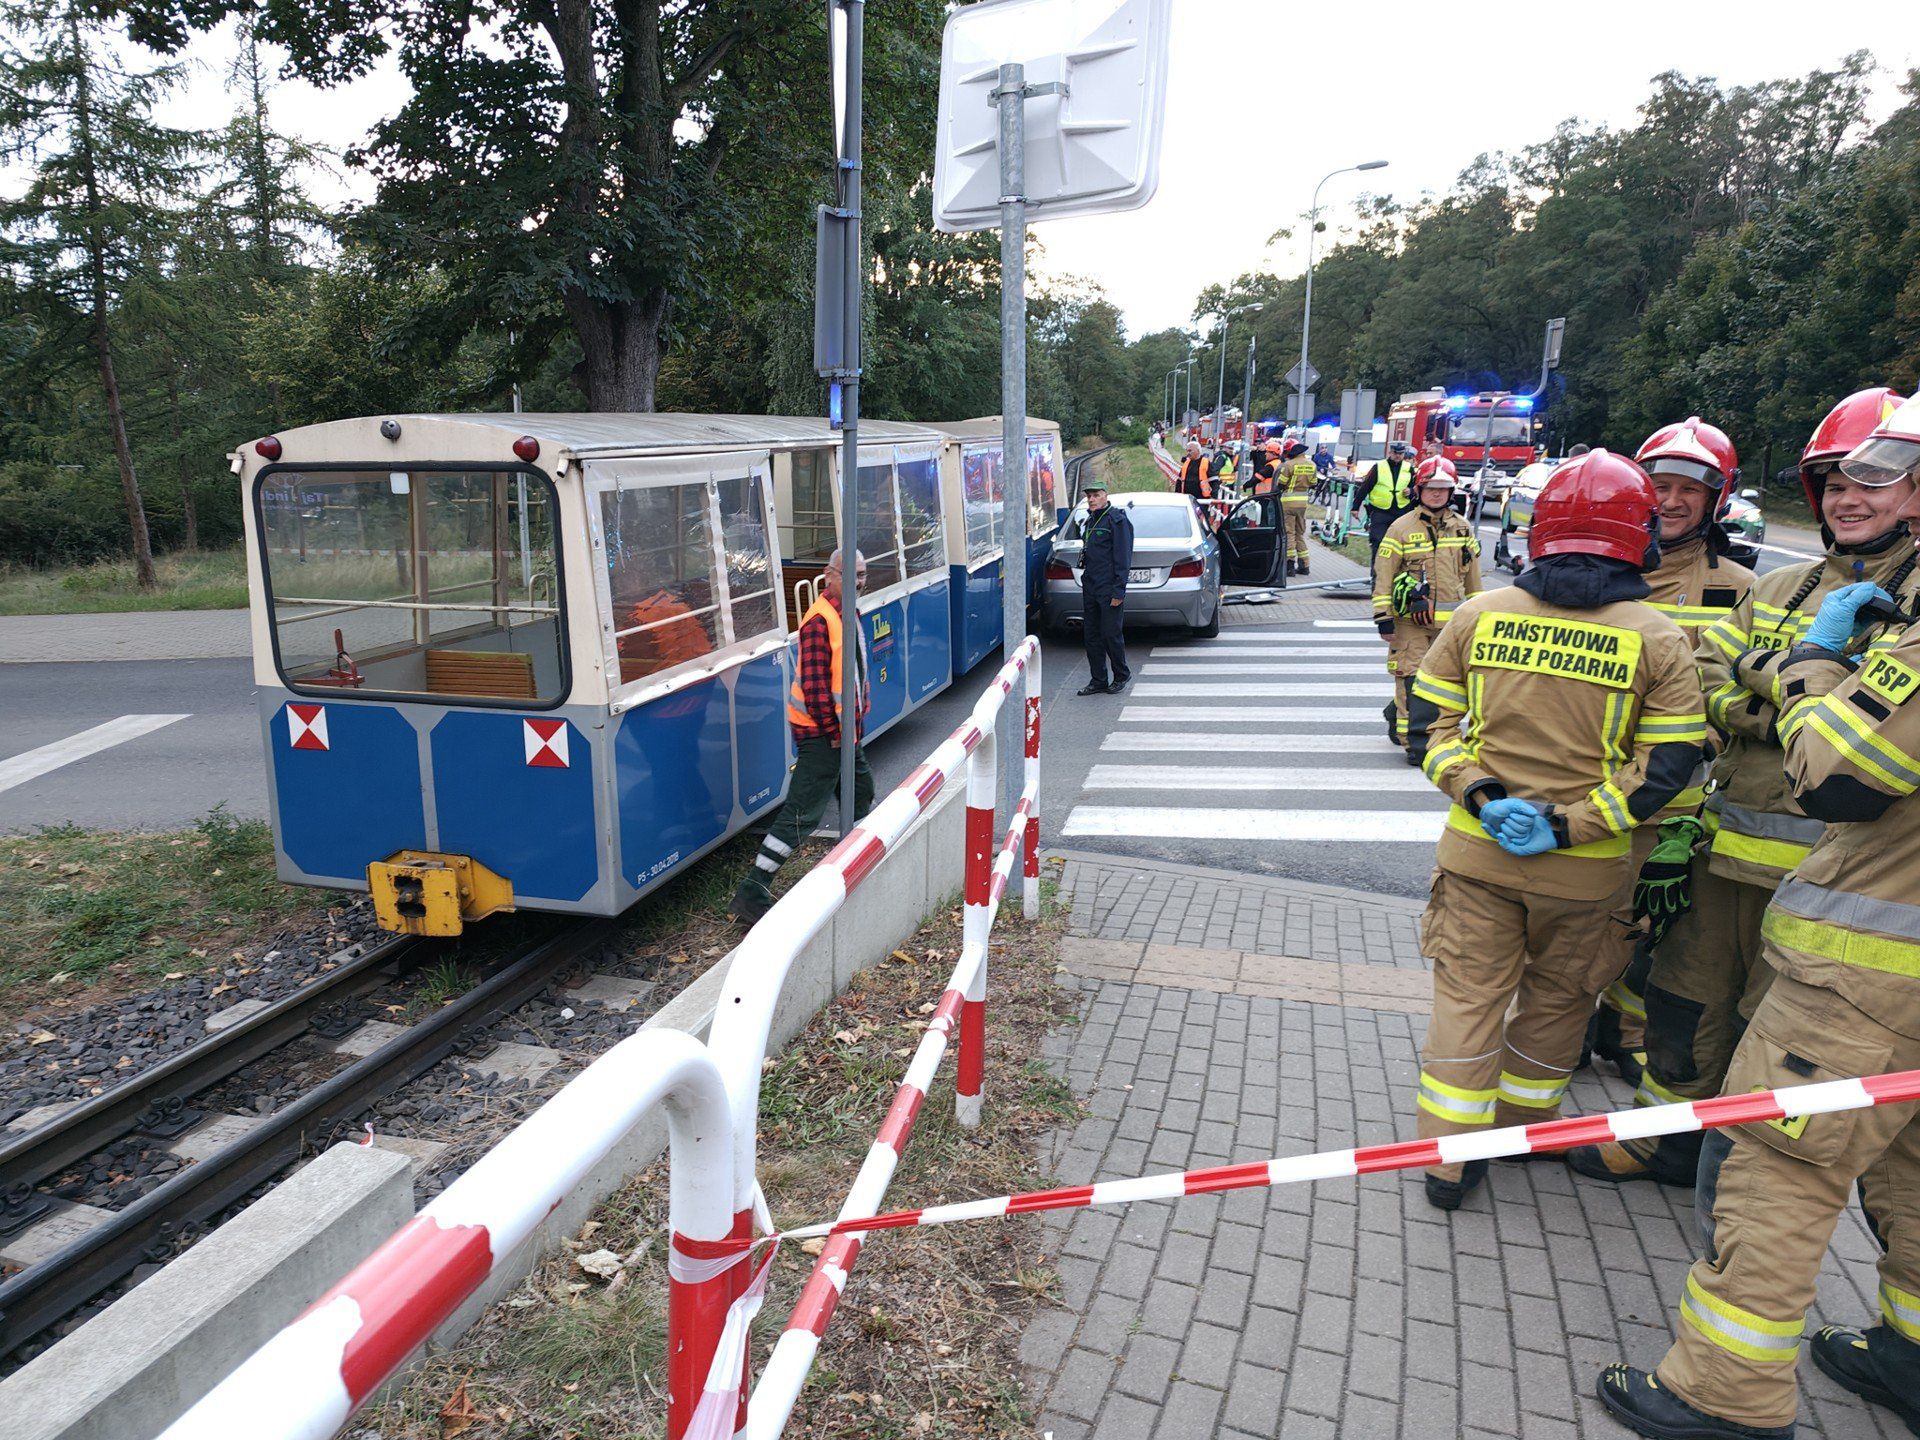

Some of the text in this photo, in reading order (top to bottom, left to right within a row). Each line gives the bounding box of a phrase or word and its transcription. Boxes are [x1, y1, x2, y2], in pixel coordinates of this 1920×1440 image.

[1492, 619, 1619, 656] PAŃSTWOWA
[1752, 634, 1782, 650] PSP
[880, 666, 887, 683] 5
[1475, 642, 1629, 683] STRAŻ POŻARNA
[1867, 658, 1912, 692] PSP
